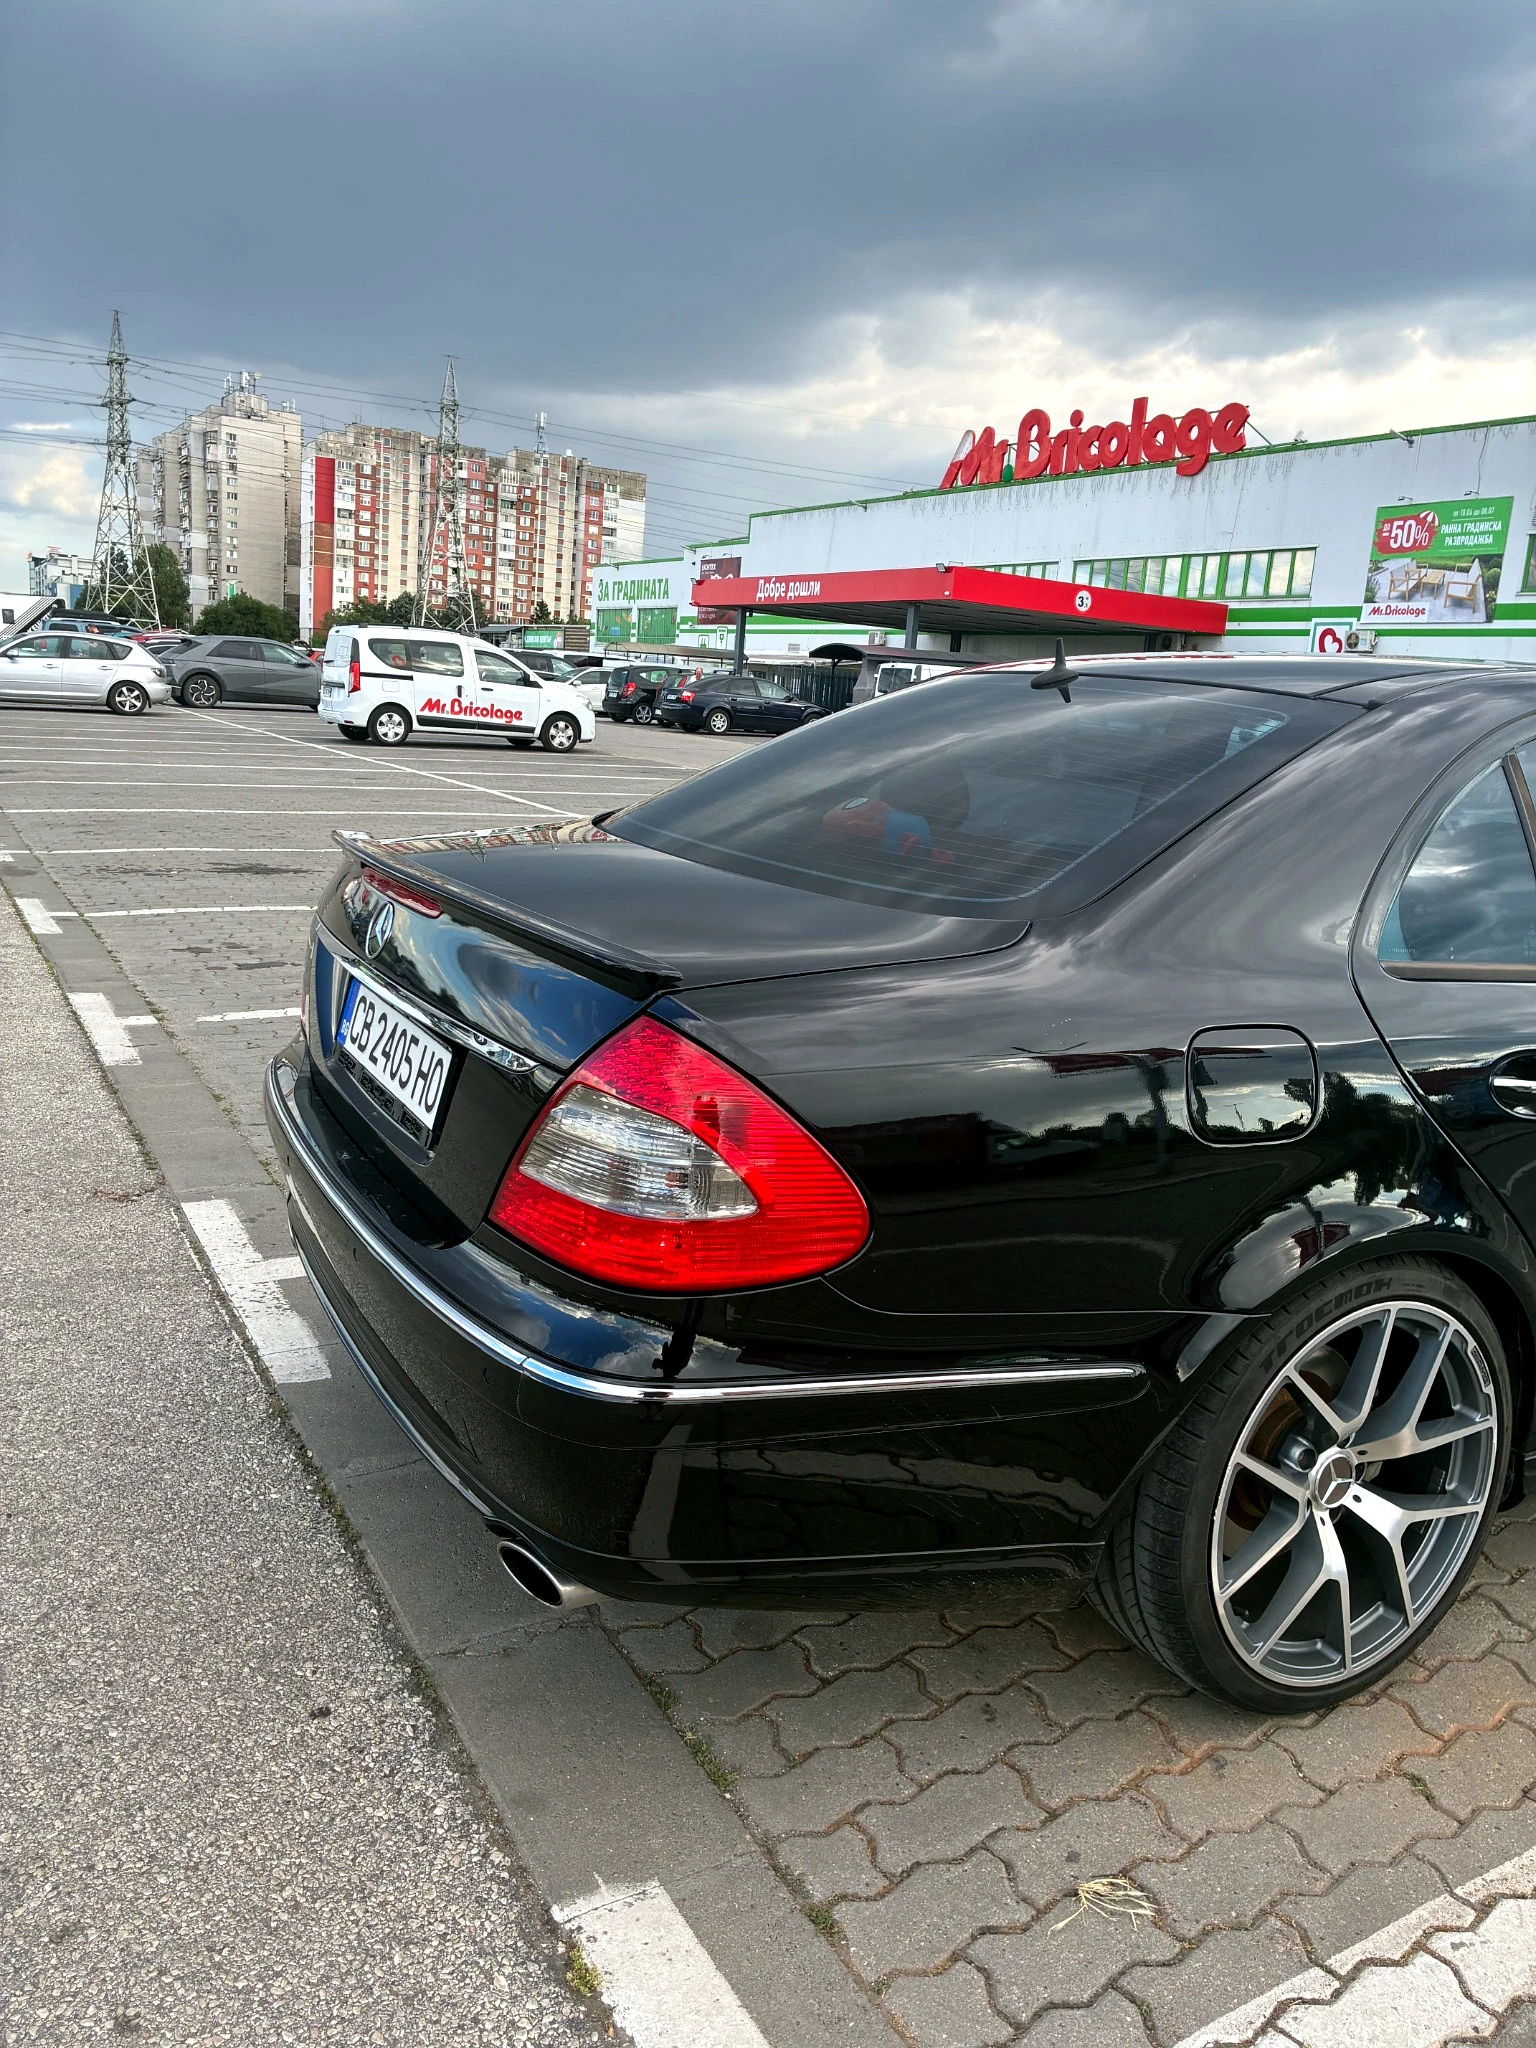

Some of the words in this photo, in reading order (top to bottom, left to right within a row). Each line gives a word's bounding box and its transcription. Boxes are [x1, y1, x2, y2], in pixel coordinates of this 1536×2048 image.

[1441, 523, 1462, 534] РАННА
[1463, 520, 1502, 534] ГРАДИНСКА
[1444, 534, 1493, 547] РАЗПРОДАЖБА
[598, 581, 609, 601] ЗА
[612, 577, 670, 604] ГРАДИНАТА
[756, 577, 786, 602] Добре
[787, 580, 820, 600] дошли
